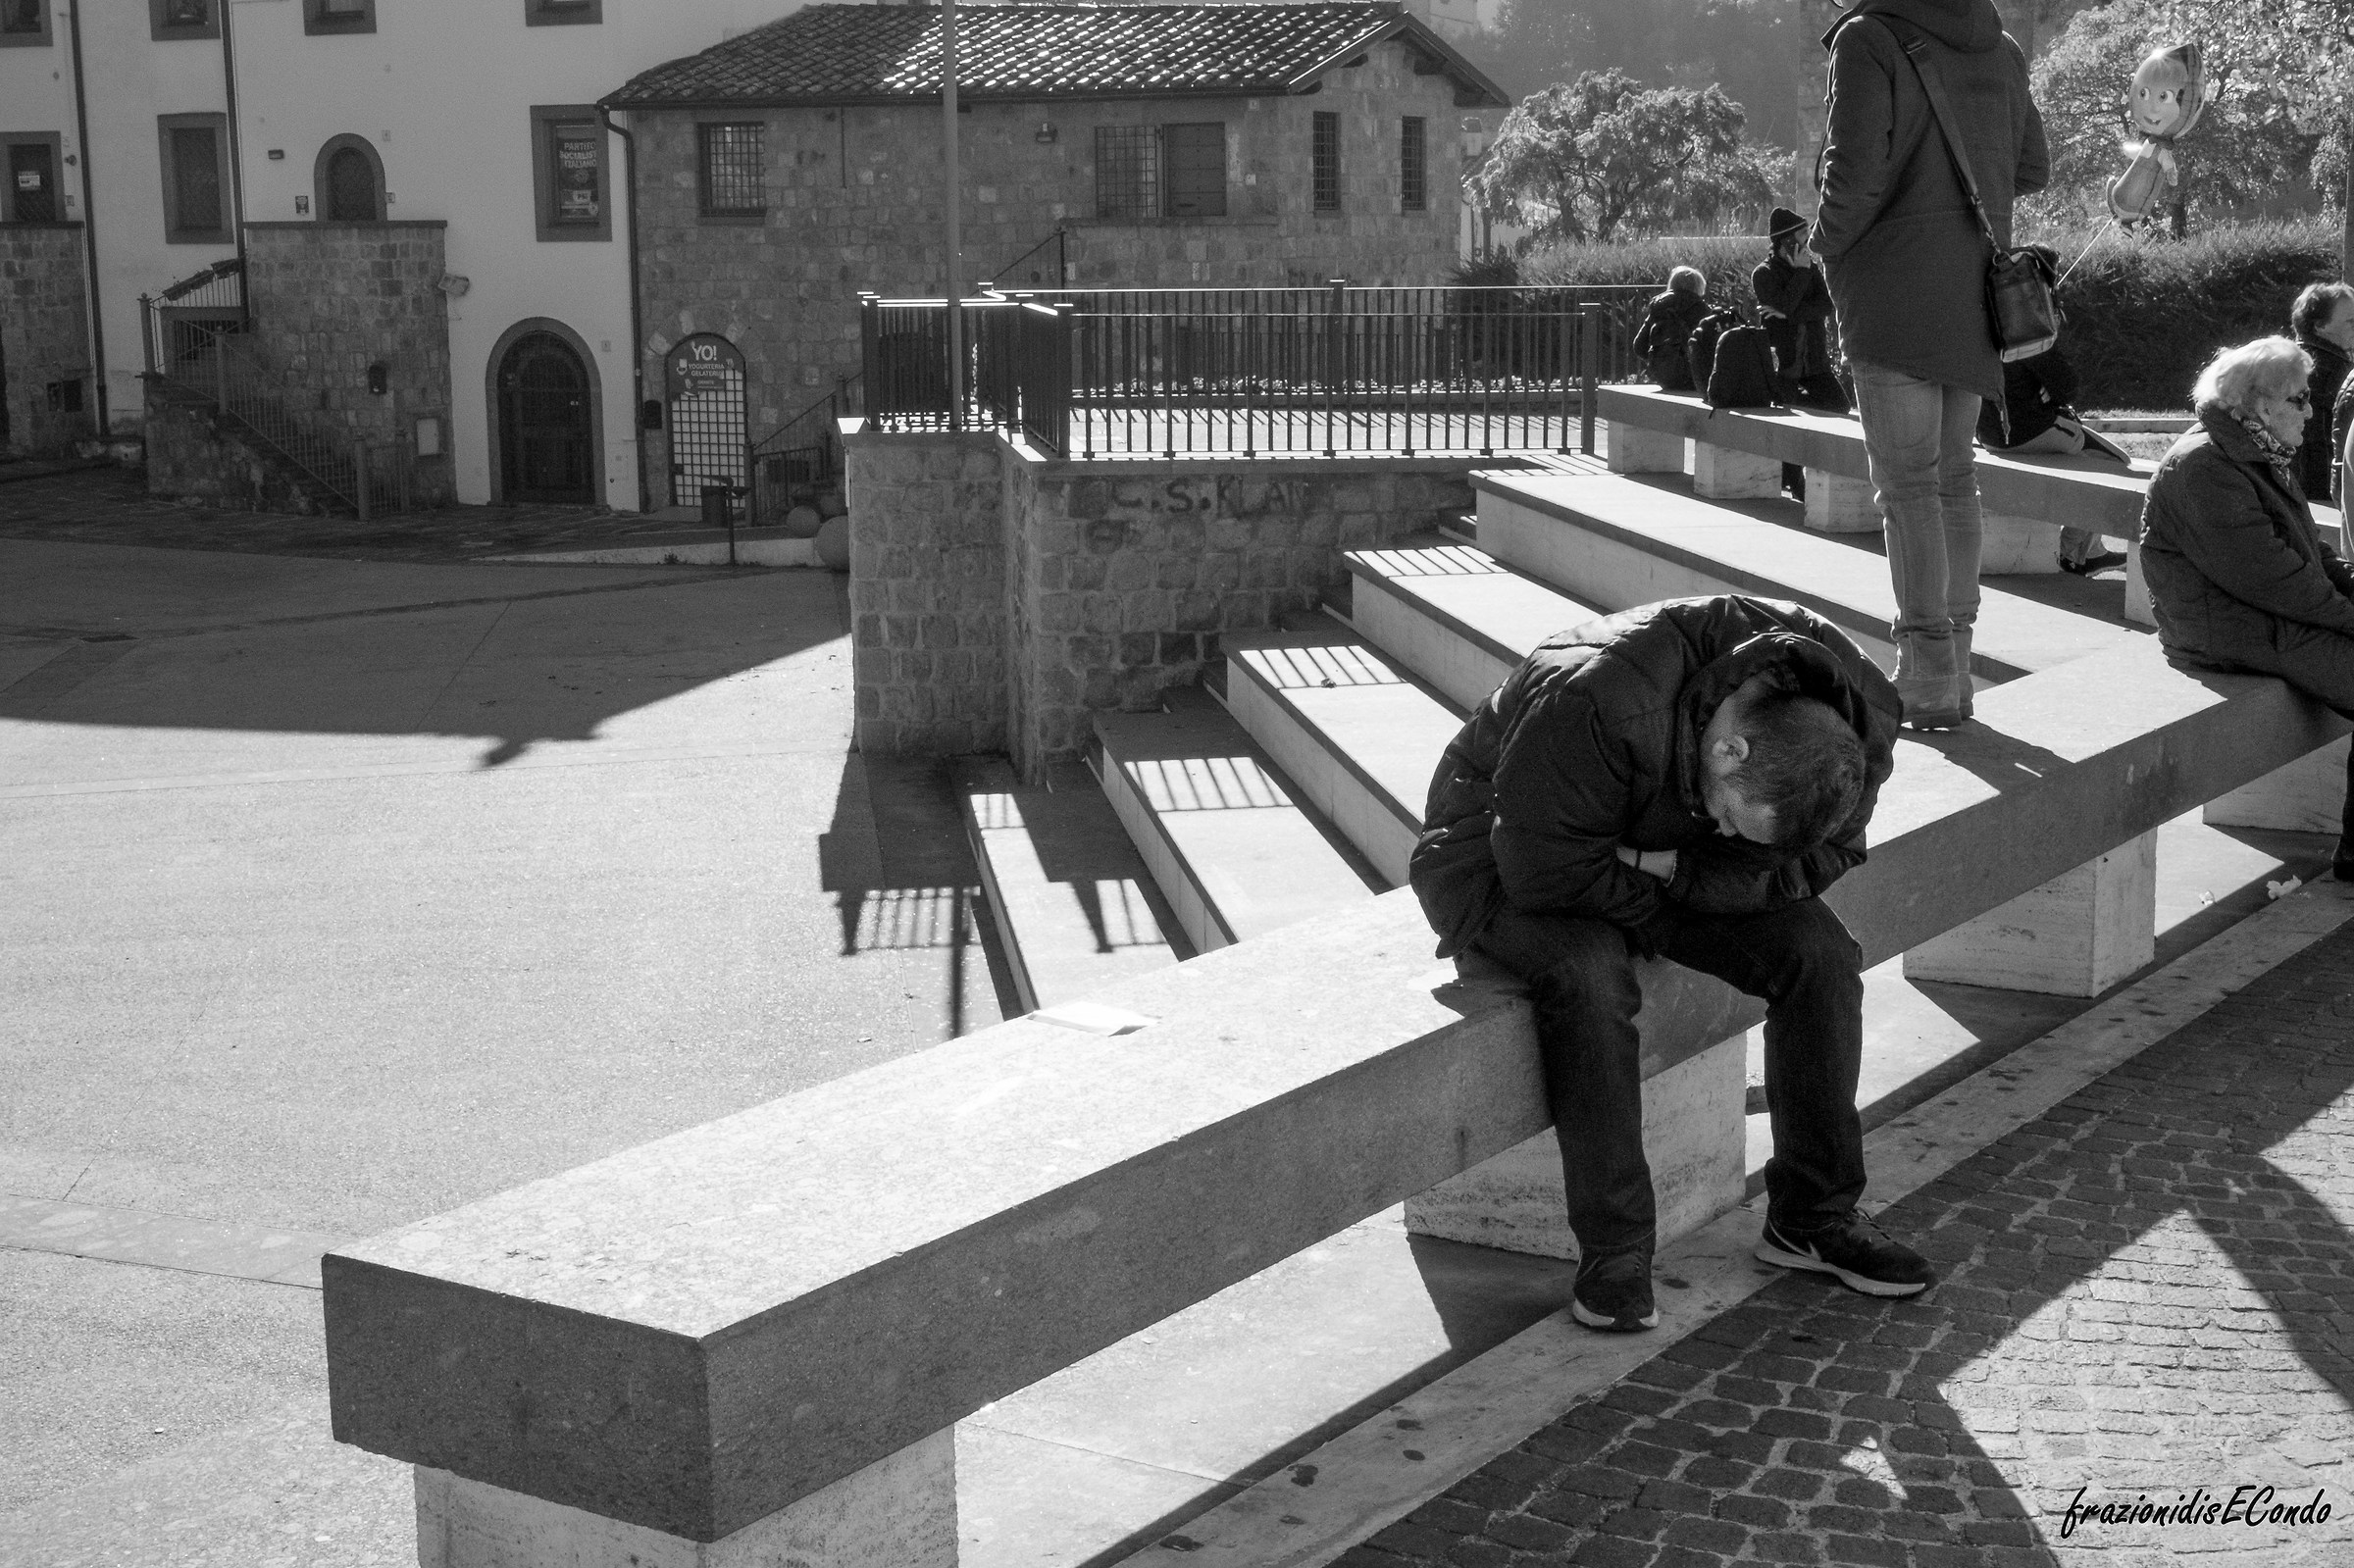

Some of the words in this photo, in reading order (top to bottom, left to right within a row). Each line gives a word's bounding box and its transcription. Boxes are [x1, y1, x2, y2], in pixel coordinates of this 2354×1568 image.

[564, 141, 596, 151] PARTITO
[564, 159, 597, 169] ITALIANO
[691, 341, 718, 361] YO!
